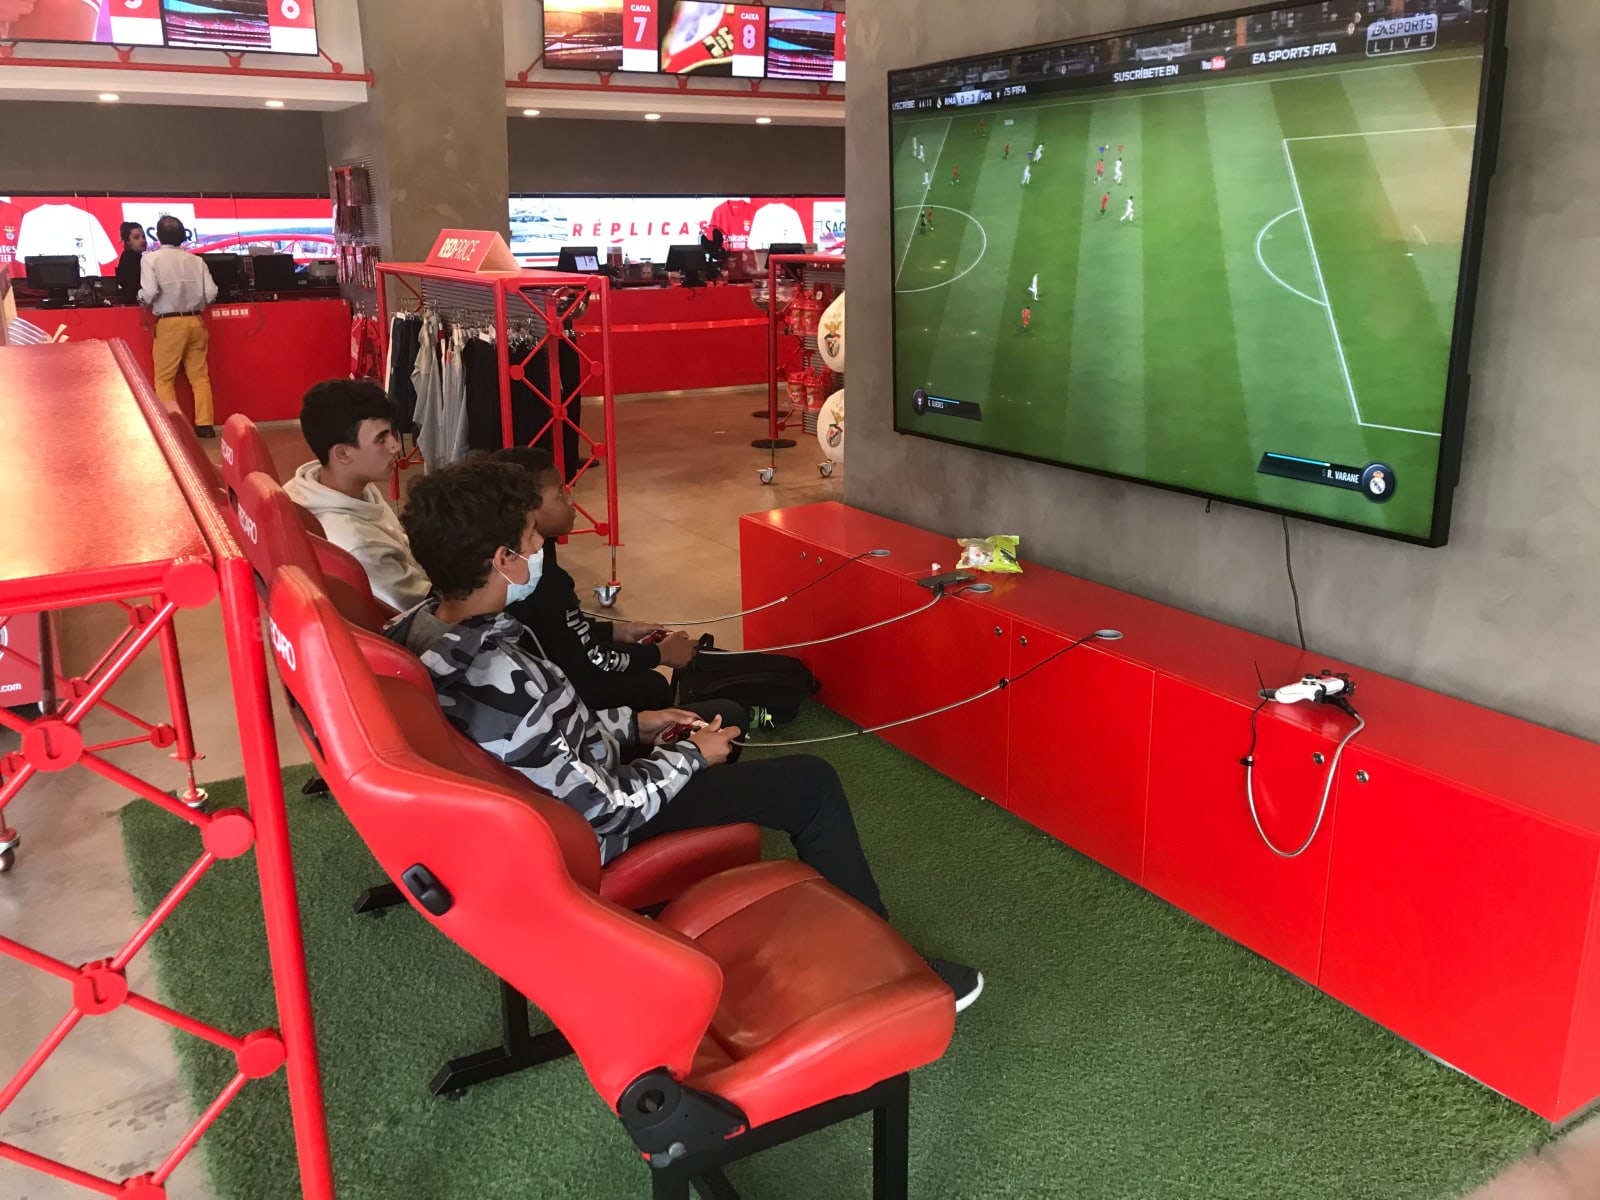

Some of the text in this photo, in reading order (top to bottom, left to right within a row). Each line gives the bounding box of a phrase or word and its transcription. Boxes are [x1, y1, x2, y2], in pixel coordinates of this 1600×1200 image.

[630, 4, 651, 13] CAIXA
[740, 12, 760, 21] CAIXA
[633, 16, 647, 42] 7
[1389, 17, 1433, 35] SPORTS
[742, 24, 757, 49] 8
[1373, 35, 1429, 53] LIVE
[1252, 42, 1338, 65] EA SPORTS FIFA
[1166, 64, 1179, 77] EN
[1011, 84, 1027, 96] FIFA
[1335, 471, 1360, 484] VARANE
